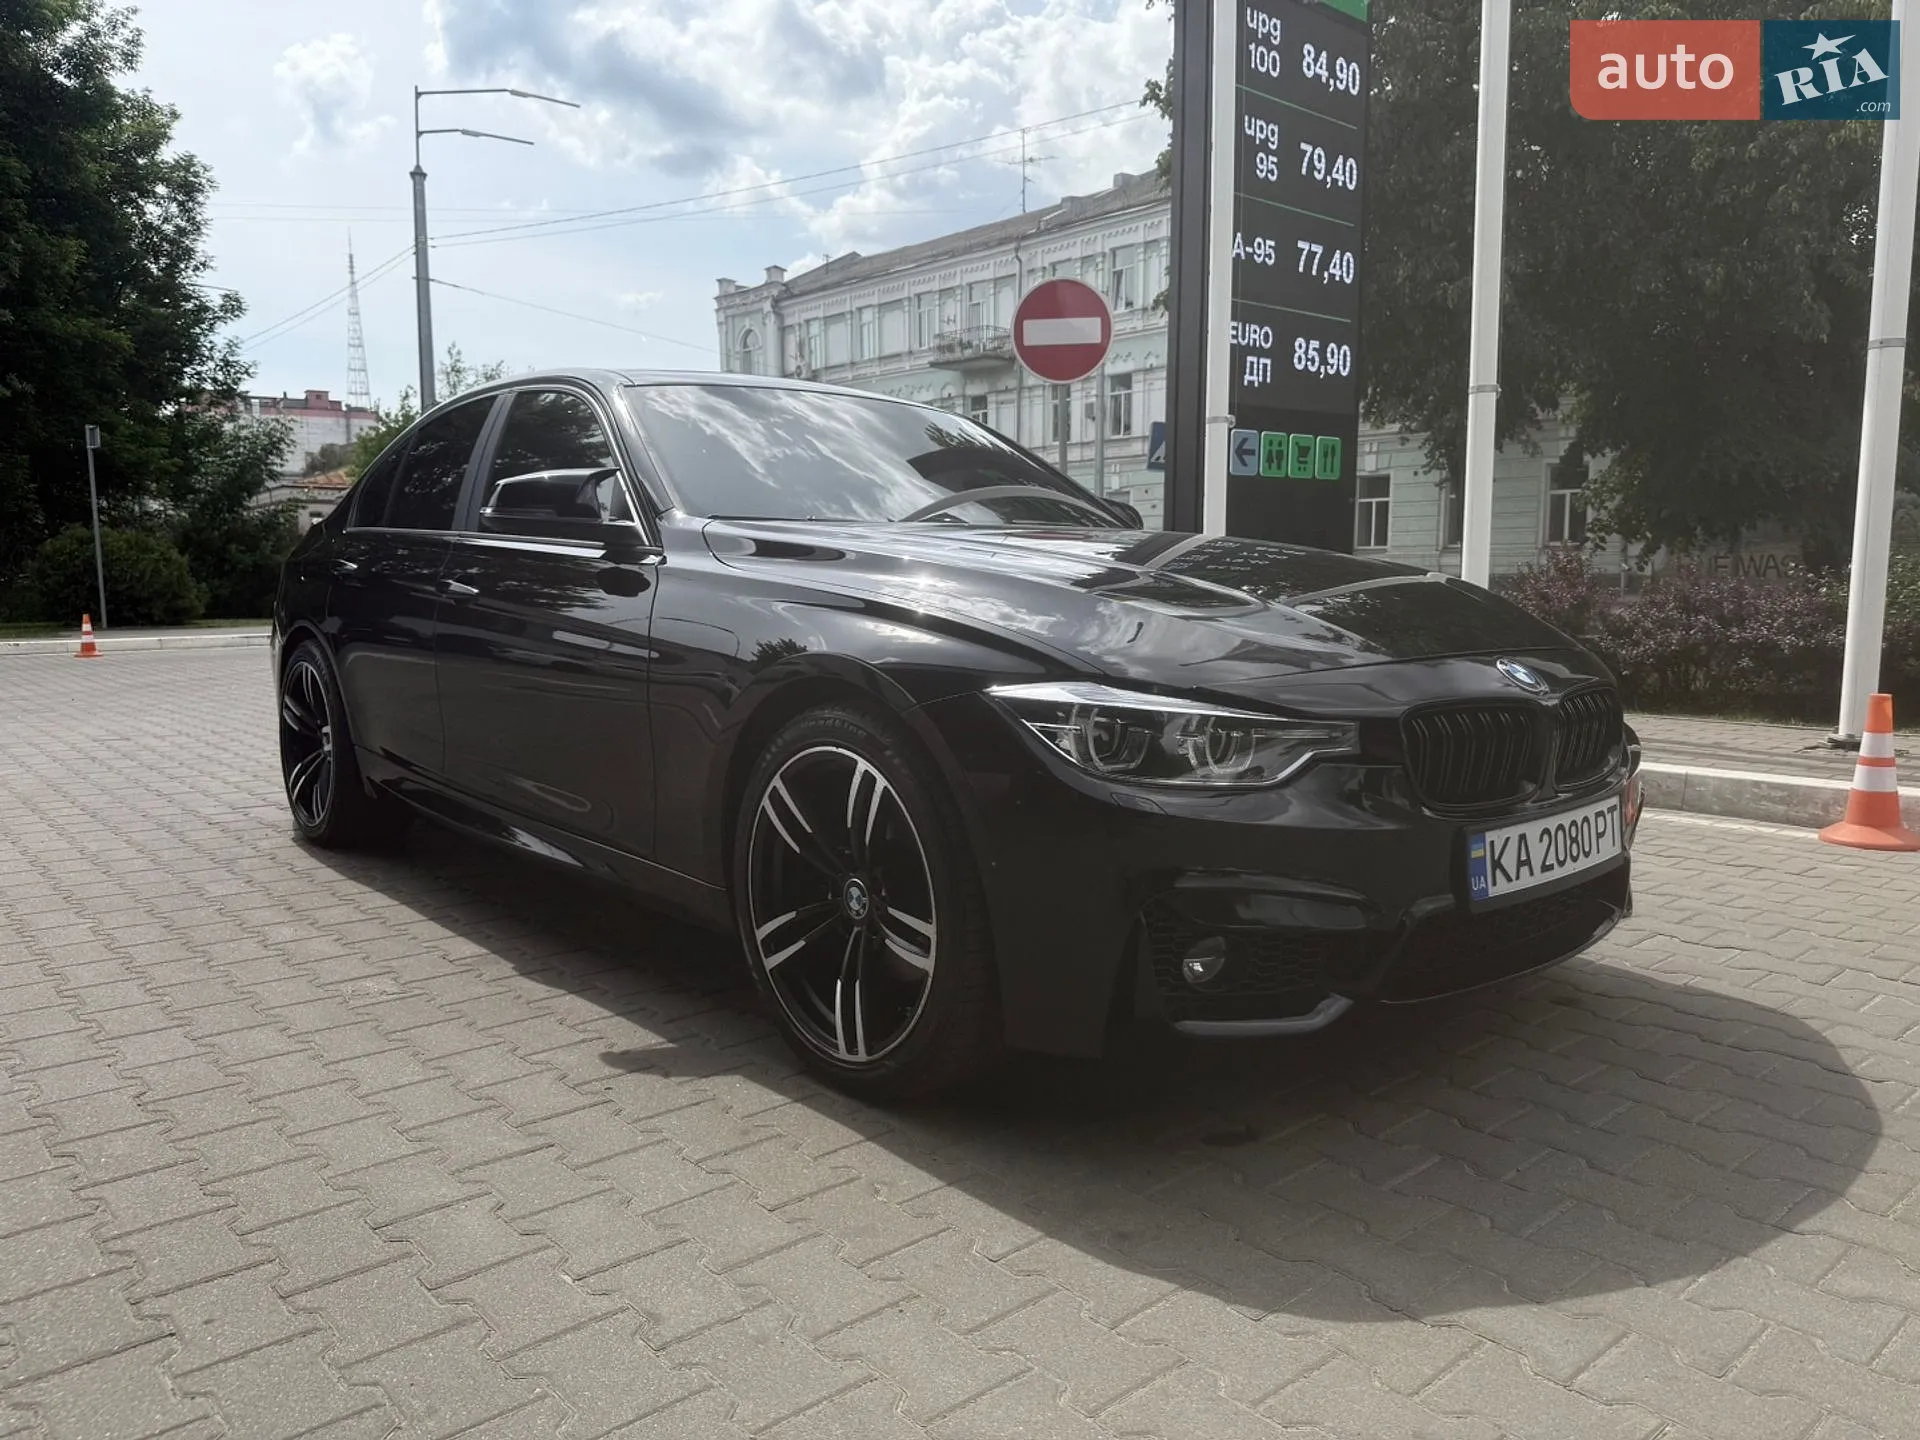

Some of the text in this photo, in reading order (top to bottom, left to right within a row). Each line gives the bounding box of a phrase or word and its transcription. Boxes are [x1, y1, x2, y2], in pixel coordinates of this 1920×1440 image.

[1246, 6, 1281, 45] upg
[1248, 42, 1361, 96] 100 84,90
[1244, 114, 1279, 150] upg
[1255, 142, 1358, 191] 95 79,40
[1231, 231, 1355, 285] A-95 77,40
[1229, 320, 1352, 379] EURO 85,90
[1243, 355, 1272, 388] ДП
[1471, 876, 1487, 891] UA
